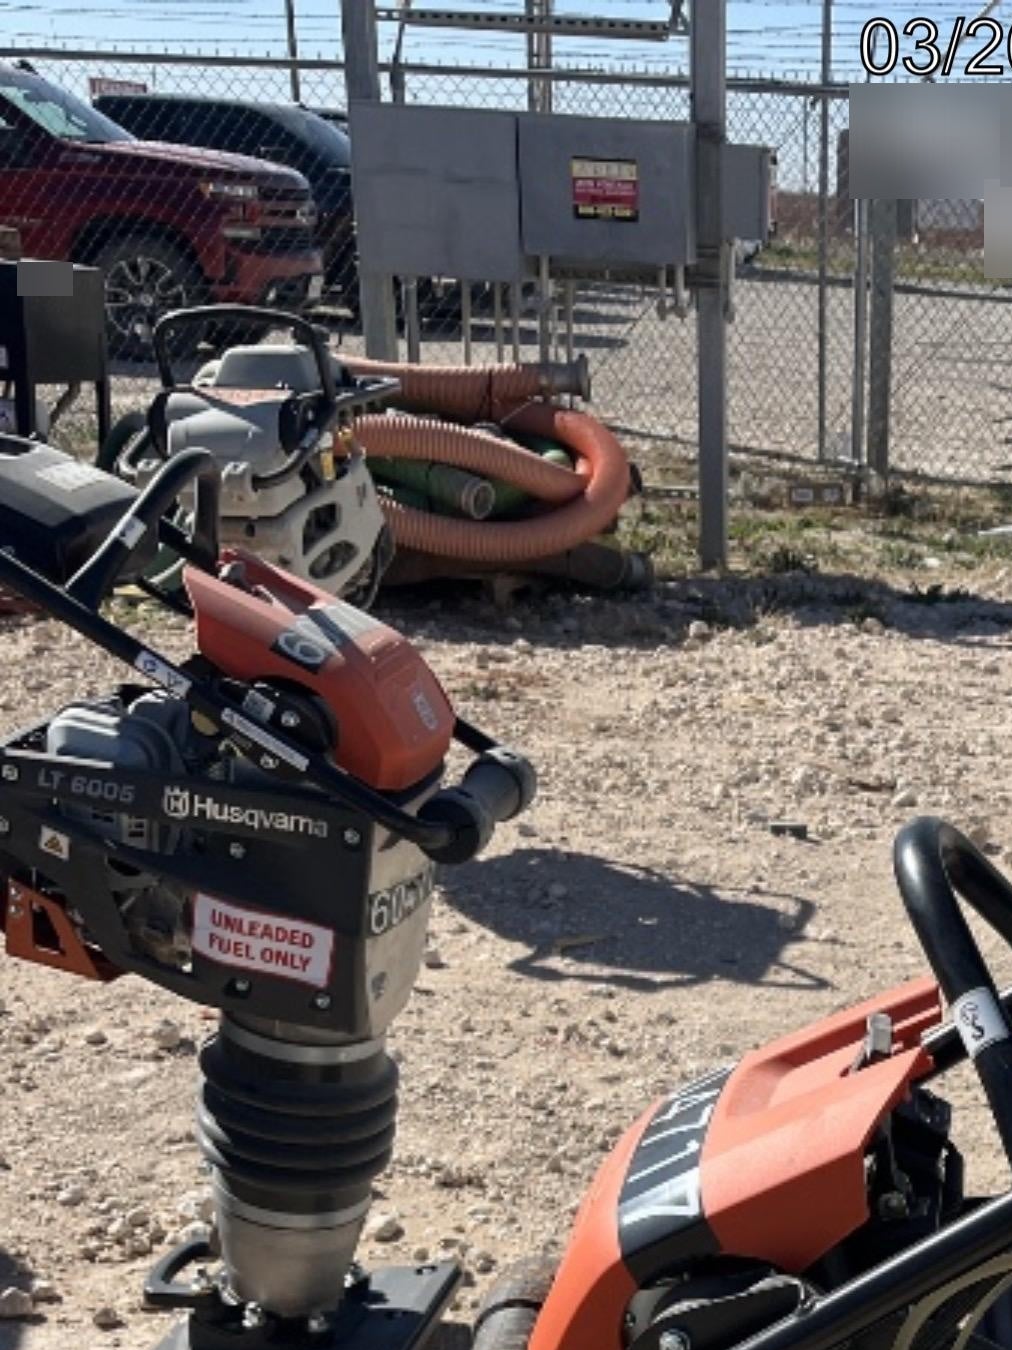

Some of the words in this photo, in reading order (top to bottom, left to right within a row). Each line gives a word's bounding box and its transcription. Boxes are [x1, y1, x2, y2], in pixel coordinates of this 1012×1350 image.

[37, 767, 65, 791] LT
[70, 775, 136, 802] 6005
[193, 794, 329, 838] Husqvarna
[210, 908, 315, 950] UNLEADED
[208, 932, 256, 961] FUEL
[260, 946, 313, 973] ONLY
